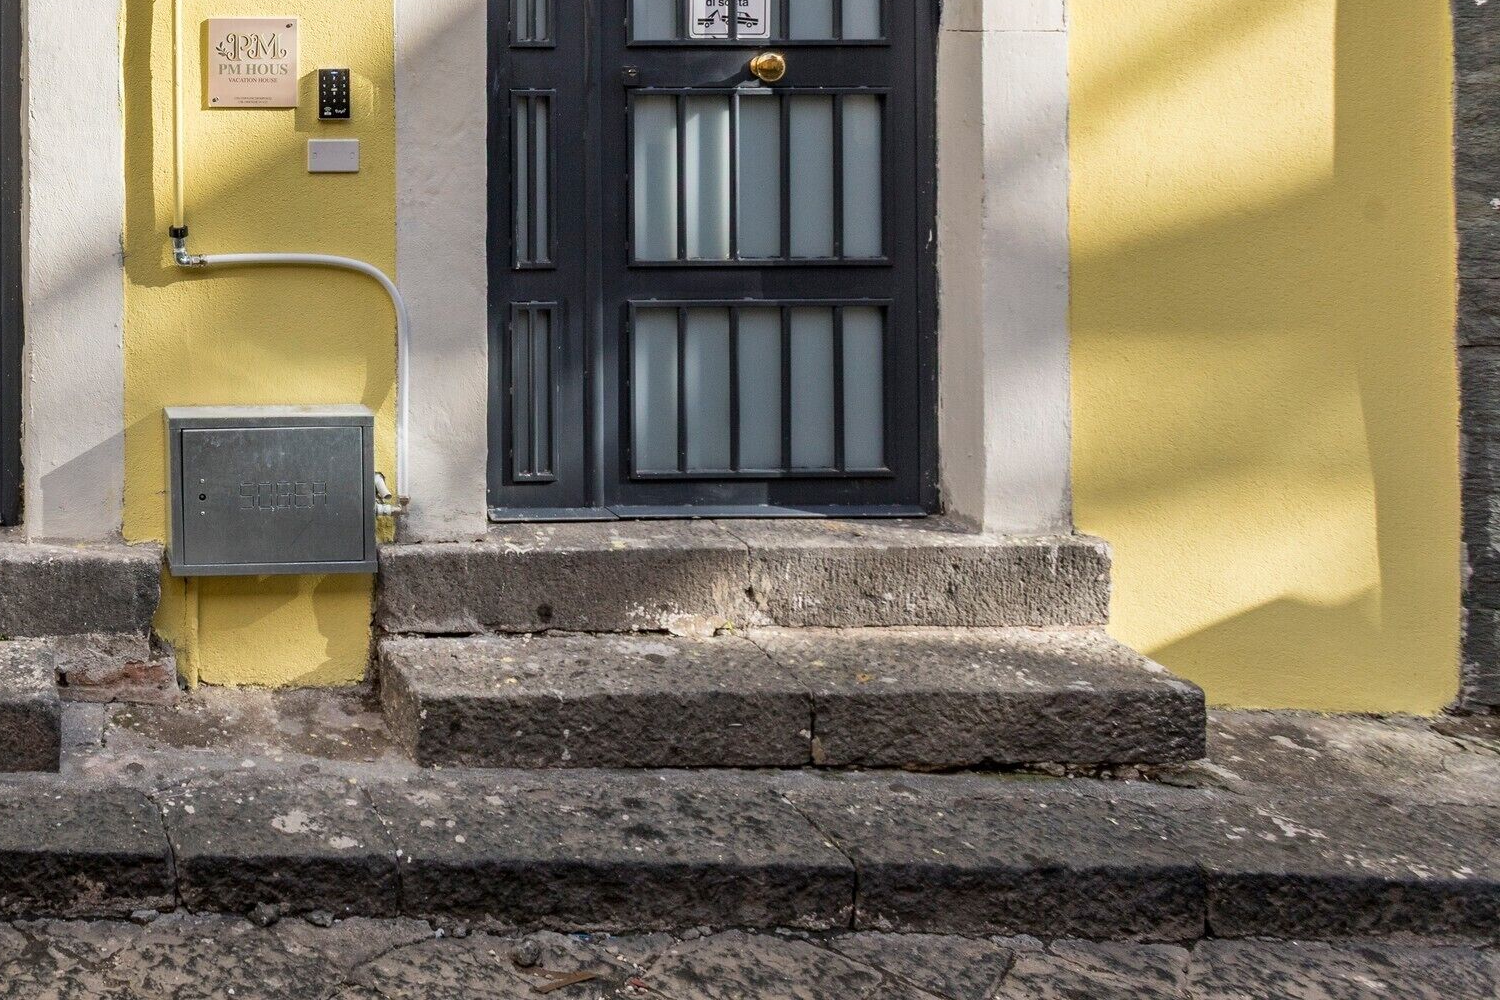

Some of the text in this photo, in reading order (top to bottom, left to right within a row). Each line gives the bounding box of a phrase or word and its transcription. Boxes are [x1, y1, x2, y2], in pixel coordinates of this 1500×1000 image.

[226, 32, 287, 61] PM
[218, 63, 288, 75] PM HOUS
